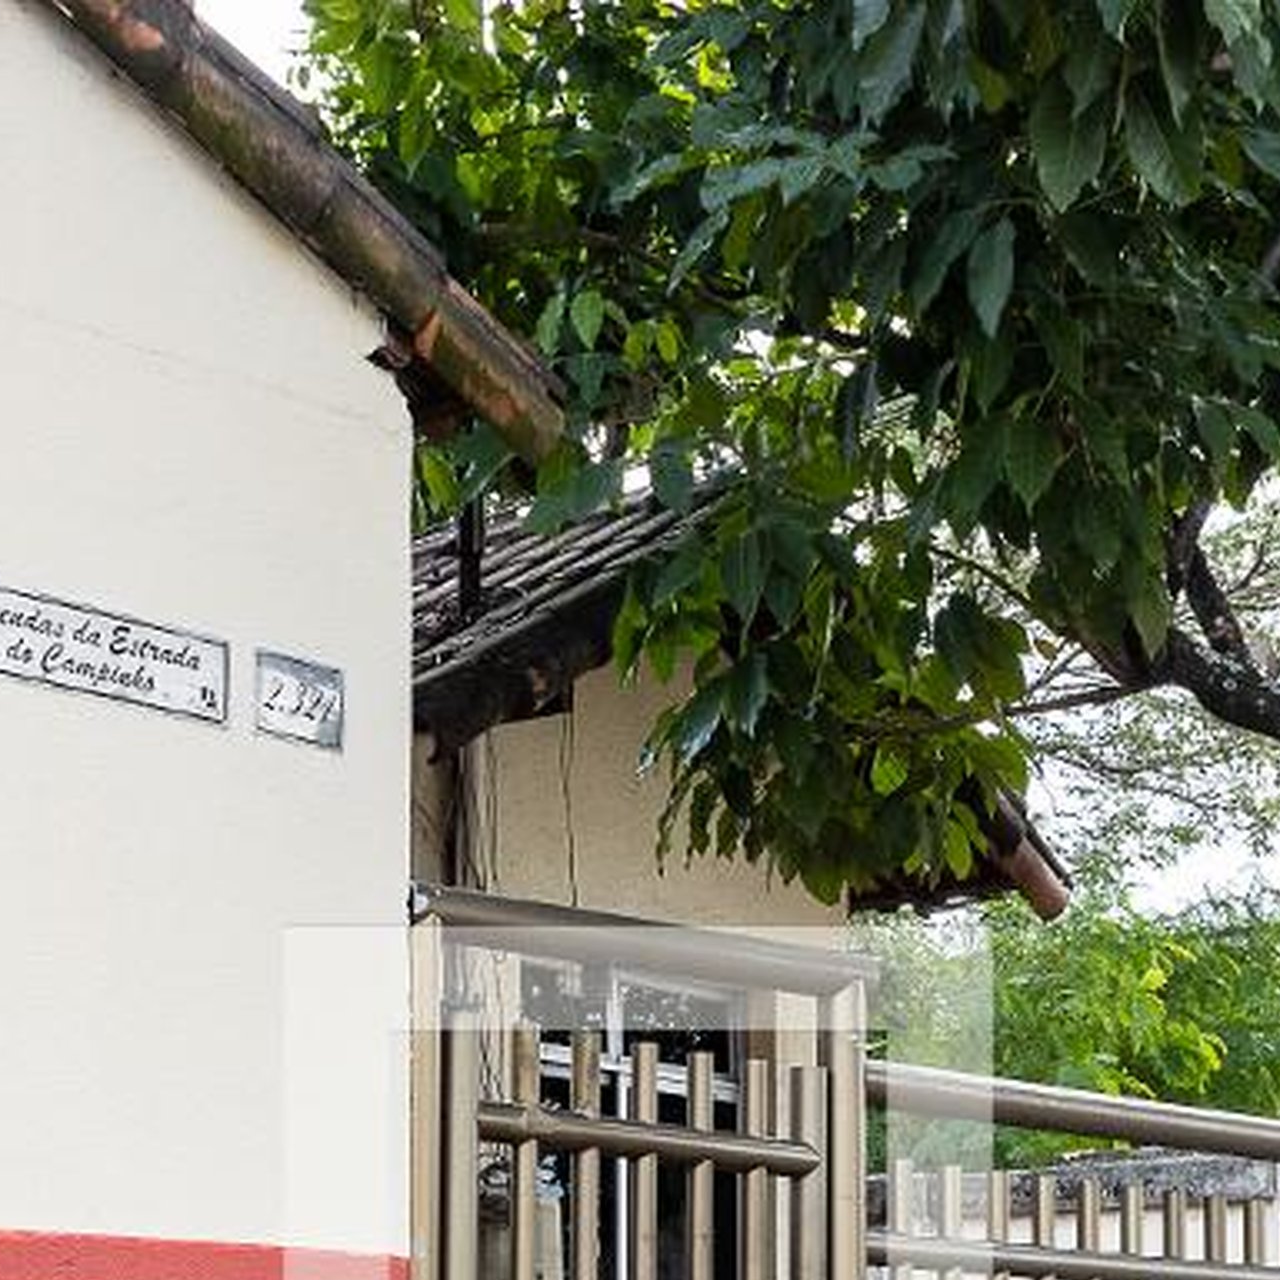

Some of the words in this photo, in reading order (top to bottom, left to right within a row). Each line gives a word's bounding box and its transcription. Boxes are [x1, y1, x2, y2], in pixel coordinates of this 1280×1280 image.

[6, 638, 33, 664] do
[41, 643, 155, 692] Campinho
[73, 620, 100, 647] da
[109, 626, 200, 671] Estrada
